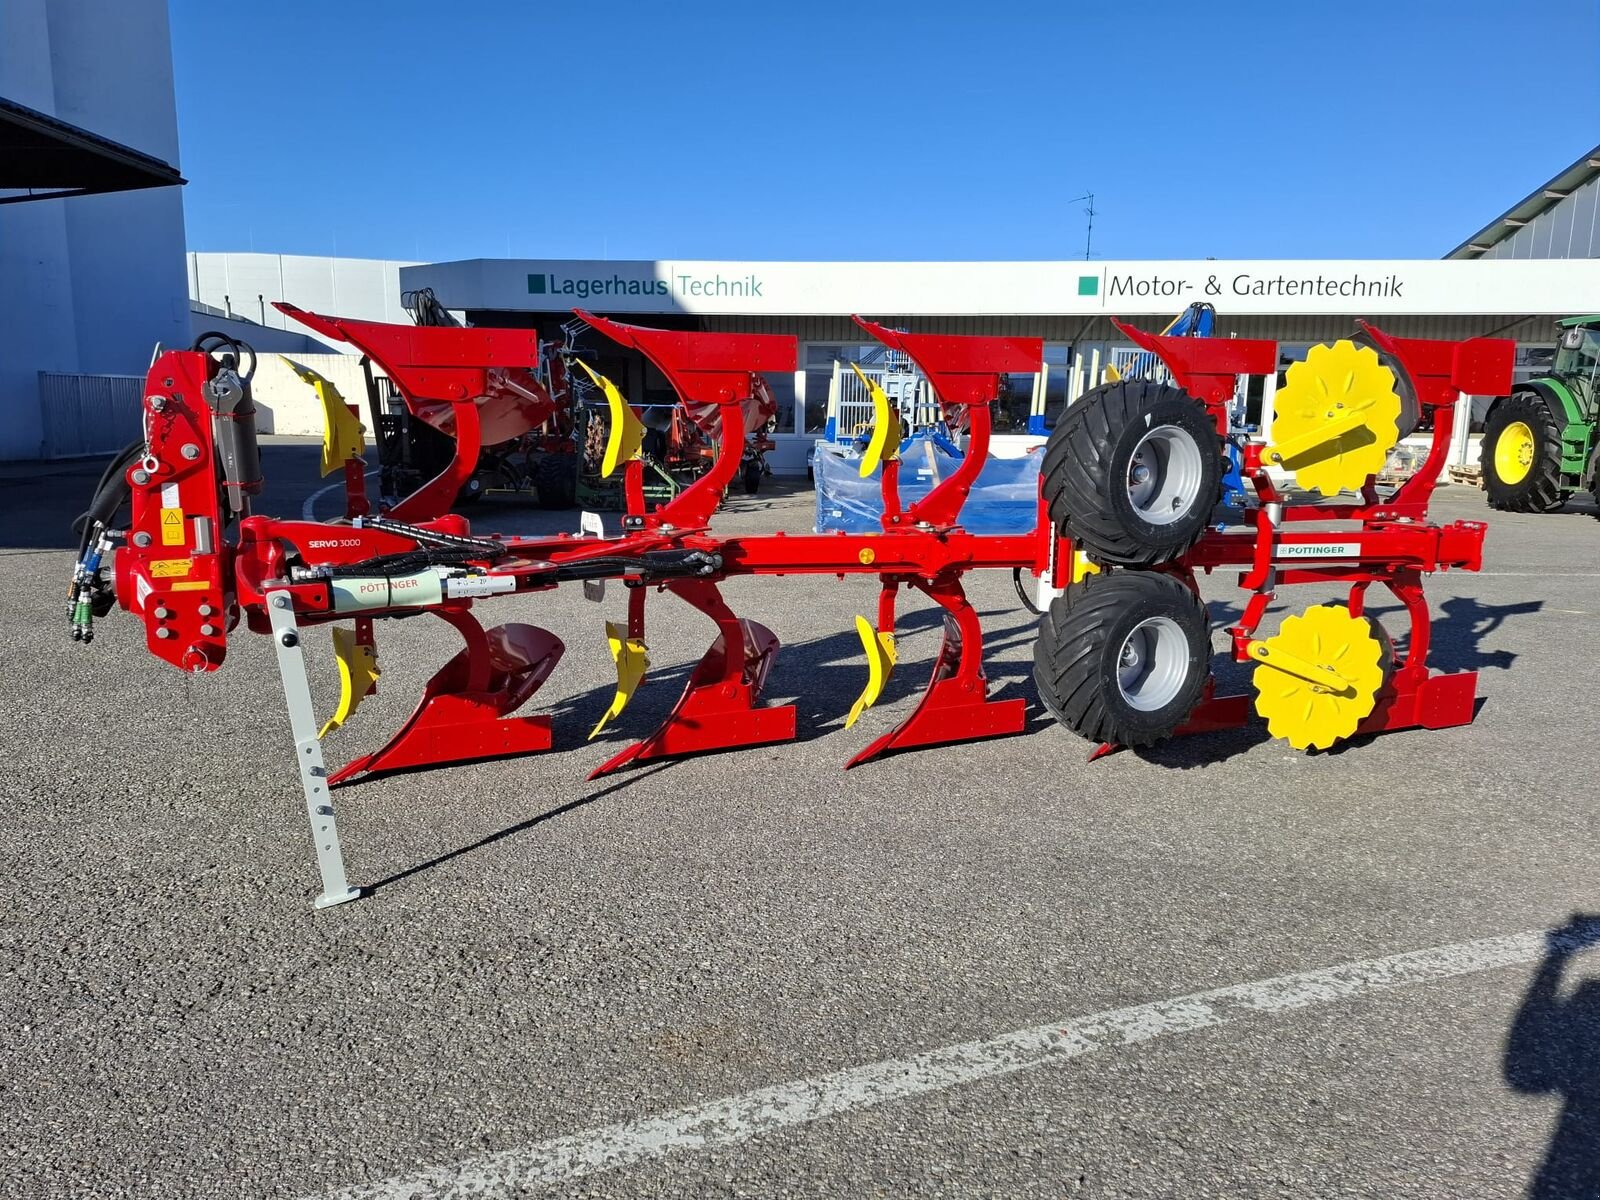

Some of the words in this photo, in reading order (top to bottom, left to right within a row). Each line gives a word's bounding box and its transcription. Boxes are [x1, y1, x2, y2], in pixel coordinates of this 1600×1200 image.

[550, 273, 668, 299] Lagerhaus
[677, 274, 763, 297] Technik
[1110, 275, 1194, 296] Motor-
[1204, 275, 1223, 296] &
[1232, 274, 1404, 298] Gartentechnik
[308, 540, 338, 549] SERVO
[340, 539, 361, 548] 3000
[360, 579, 419, 594] PÖTTNGER
